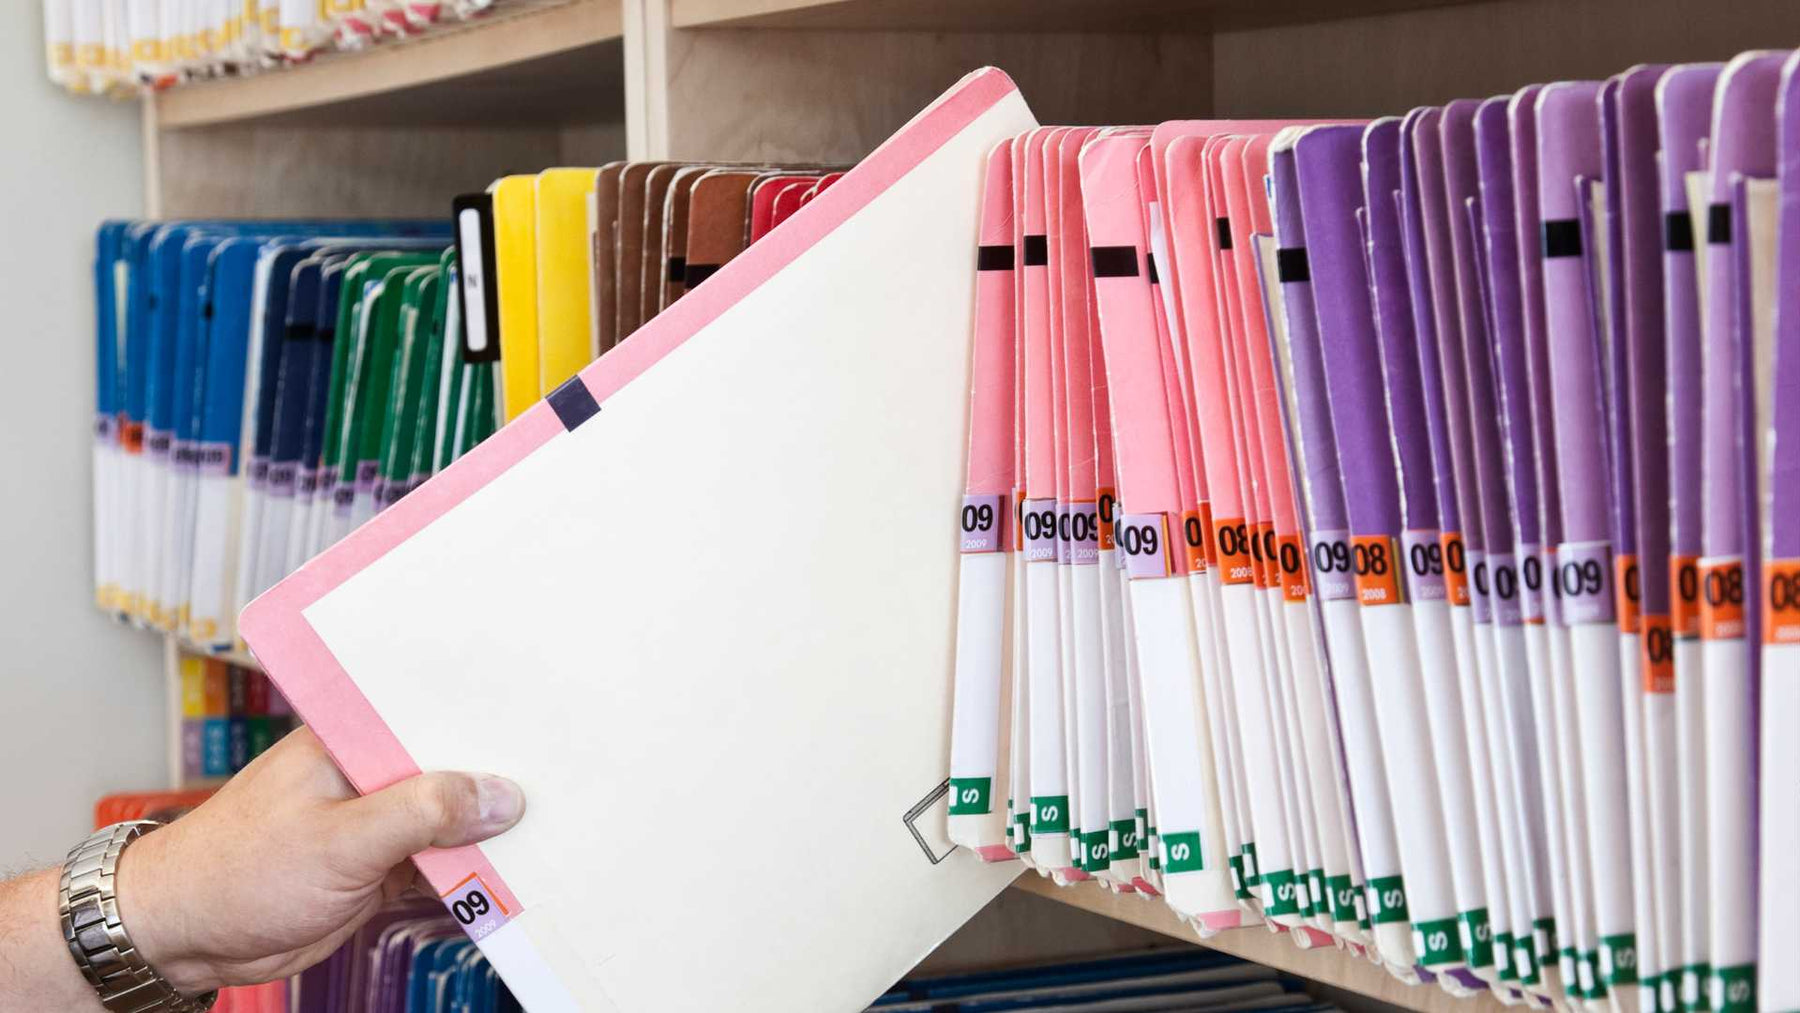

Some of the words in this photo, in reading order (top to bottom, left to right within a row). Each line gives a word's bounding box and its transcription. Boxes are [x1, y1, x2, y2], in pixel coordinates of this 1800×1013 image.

[961, 504, 994, 532] 09
[1024, 511, 1057, 541] 09
[966, 539, 988, 549] 2009
[1124, 525, 1158, 556] 09
[1218, 525, 1249, 556] 08
[1314, 541, 1350, 573] 09
[1352, 543, 1387, 576] 08
[1411, 543, 1443, 576] 09
[1562, 559, 1602, 596] 09
[1705, 567, 1743, 607] 08
[1363, 588, 1387, 600] 2008
[962, 788, 980, 804] S
[1041, 805, 1059, 822] S
[1171, 843, 1190, 861] S
[452, 890, 490, 925] 09
[1384, 889, 1403, 908] S
[475, 919, 497, 938] 2009
[1428, 931, 1448, 952] S
